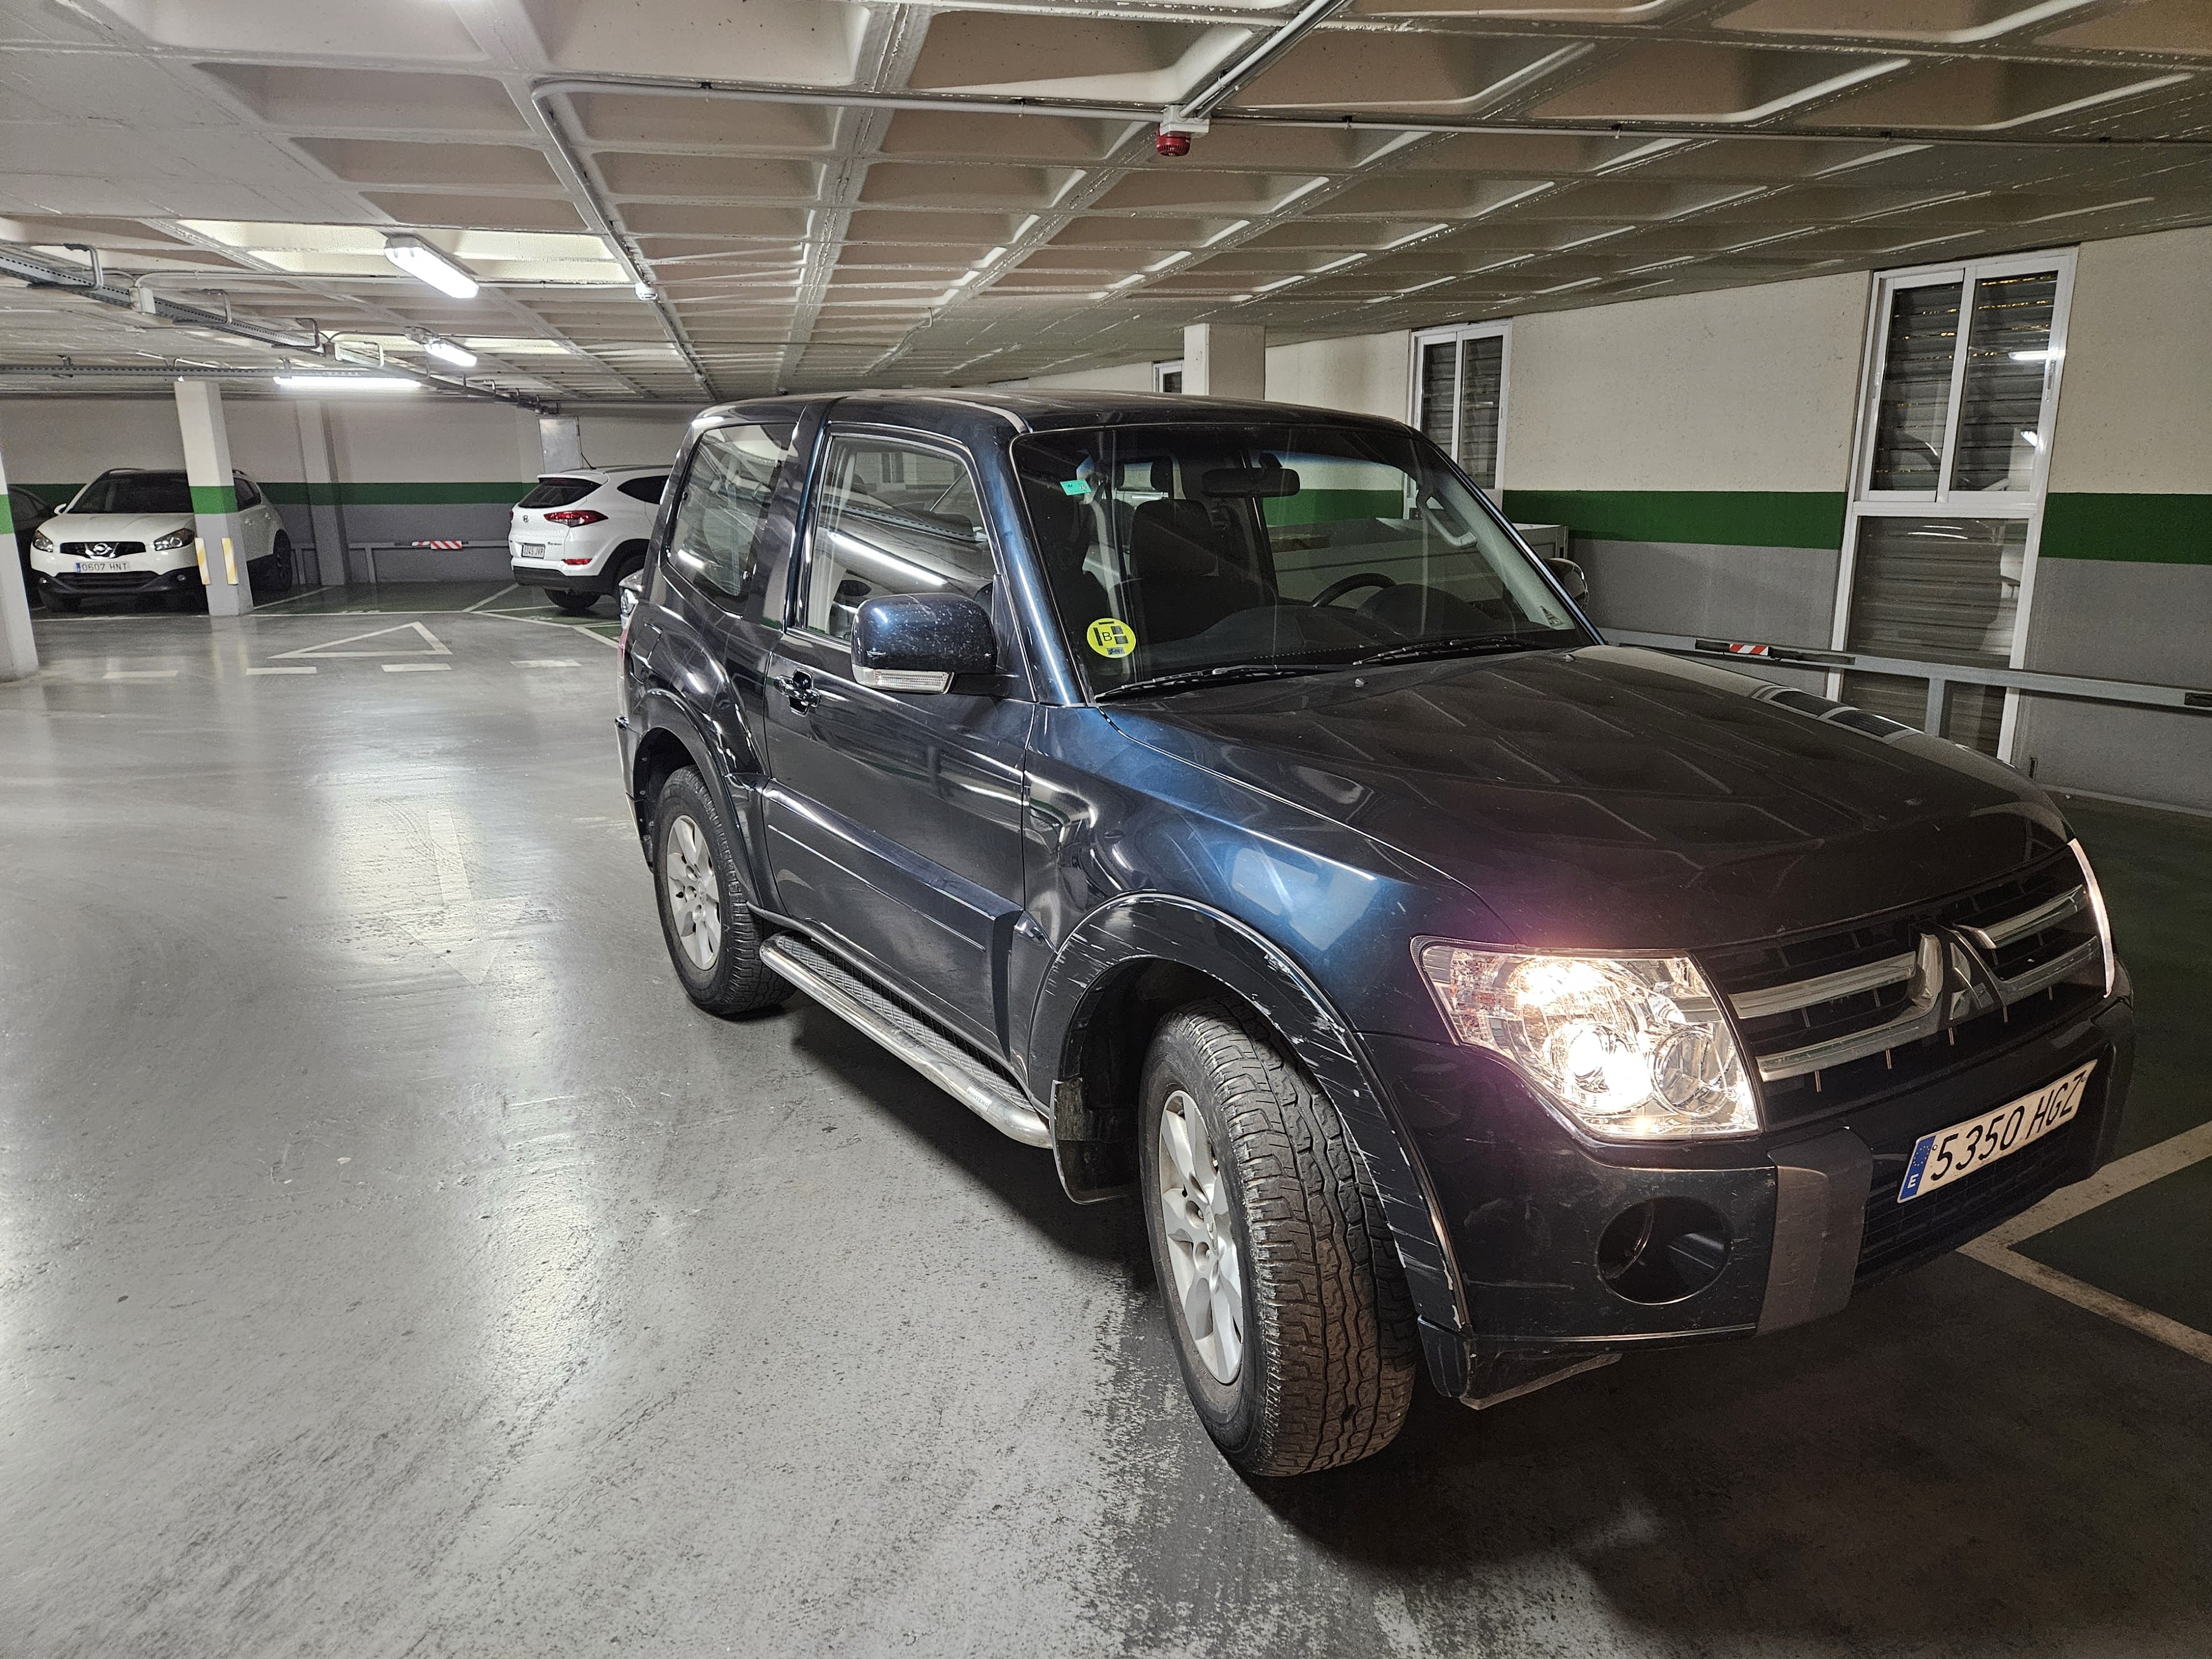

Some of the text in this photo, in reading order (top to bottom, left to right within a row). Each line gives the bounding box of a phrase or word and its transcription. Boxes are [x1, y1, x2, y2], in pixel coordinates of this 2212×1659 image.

[1102, 632, 1112, 641] B
[1931, 1070, 2087, 1181] 5350 HGZ
[1907, 1173, 1919, 1188] E
